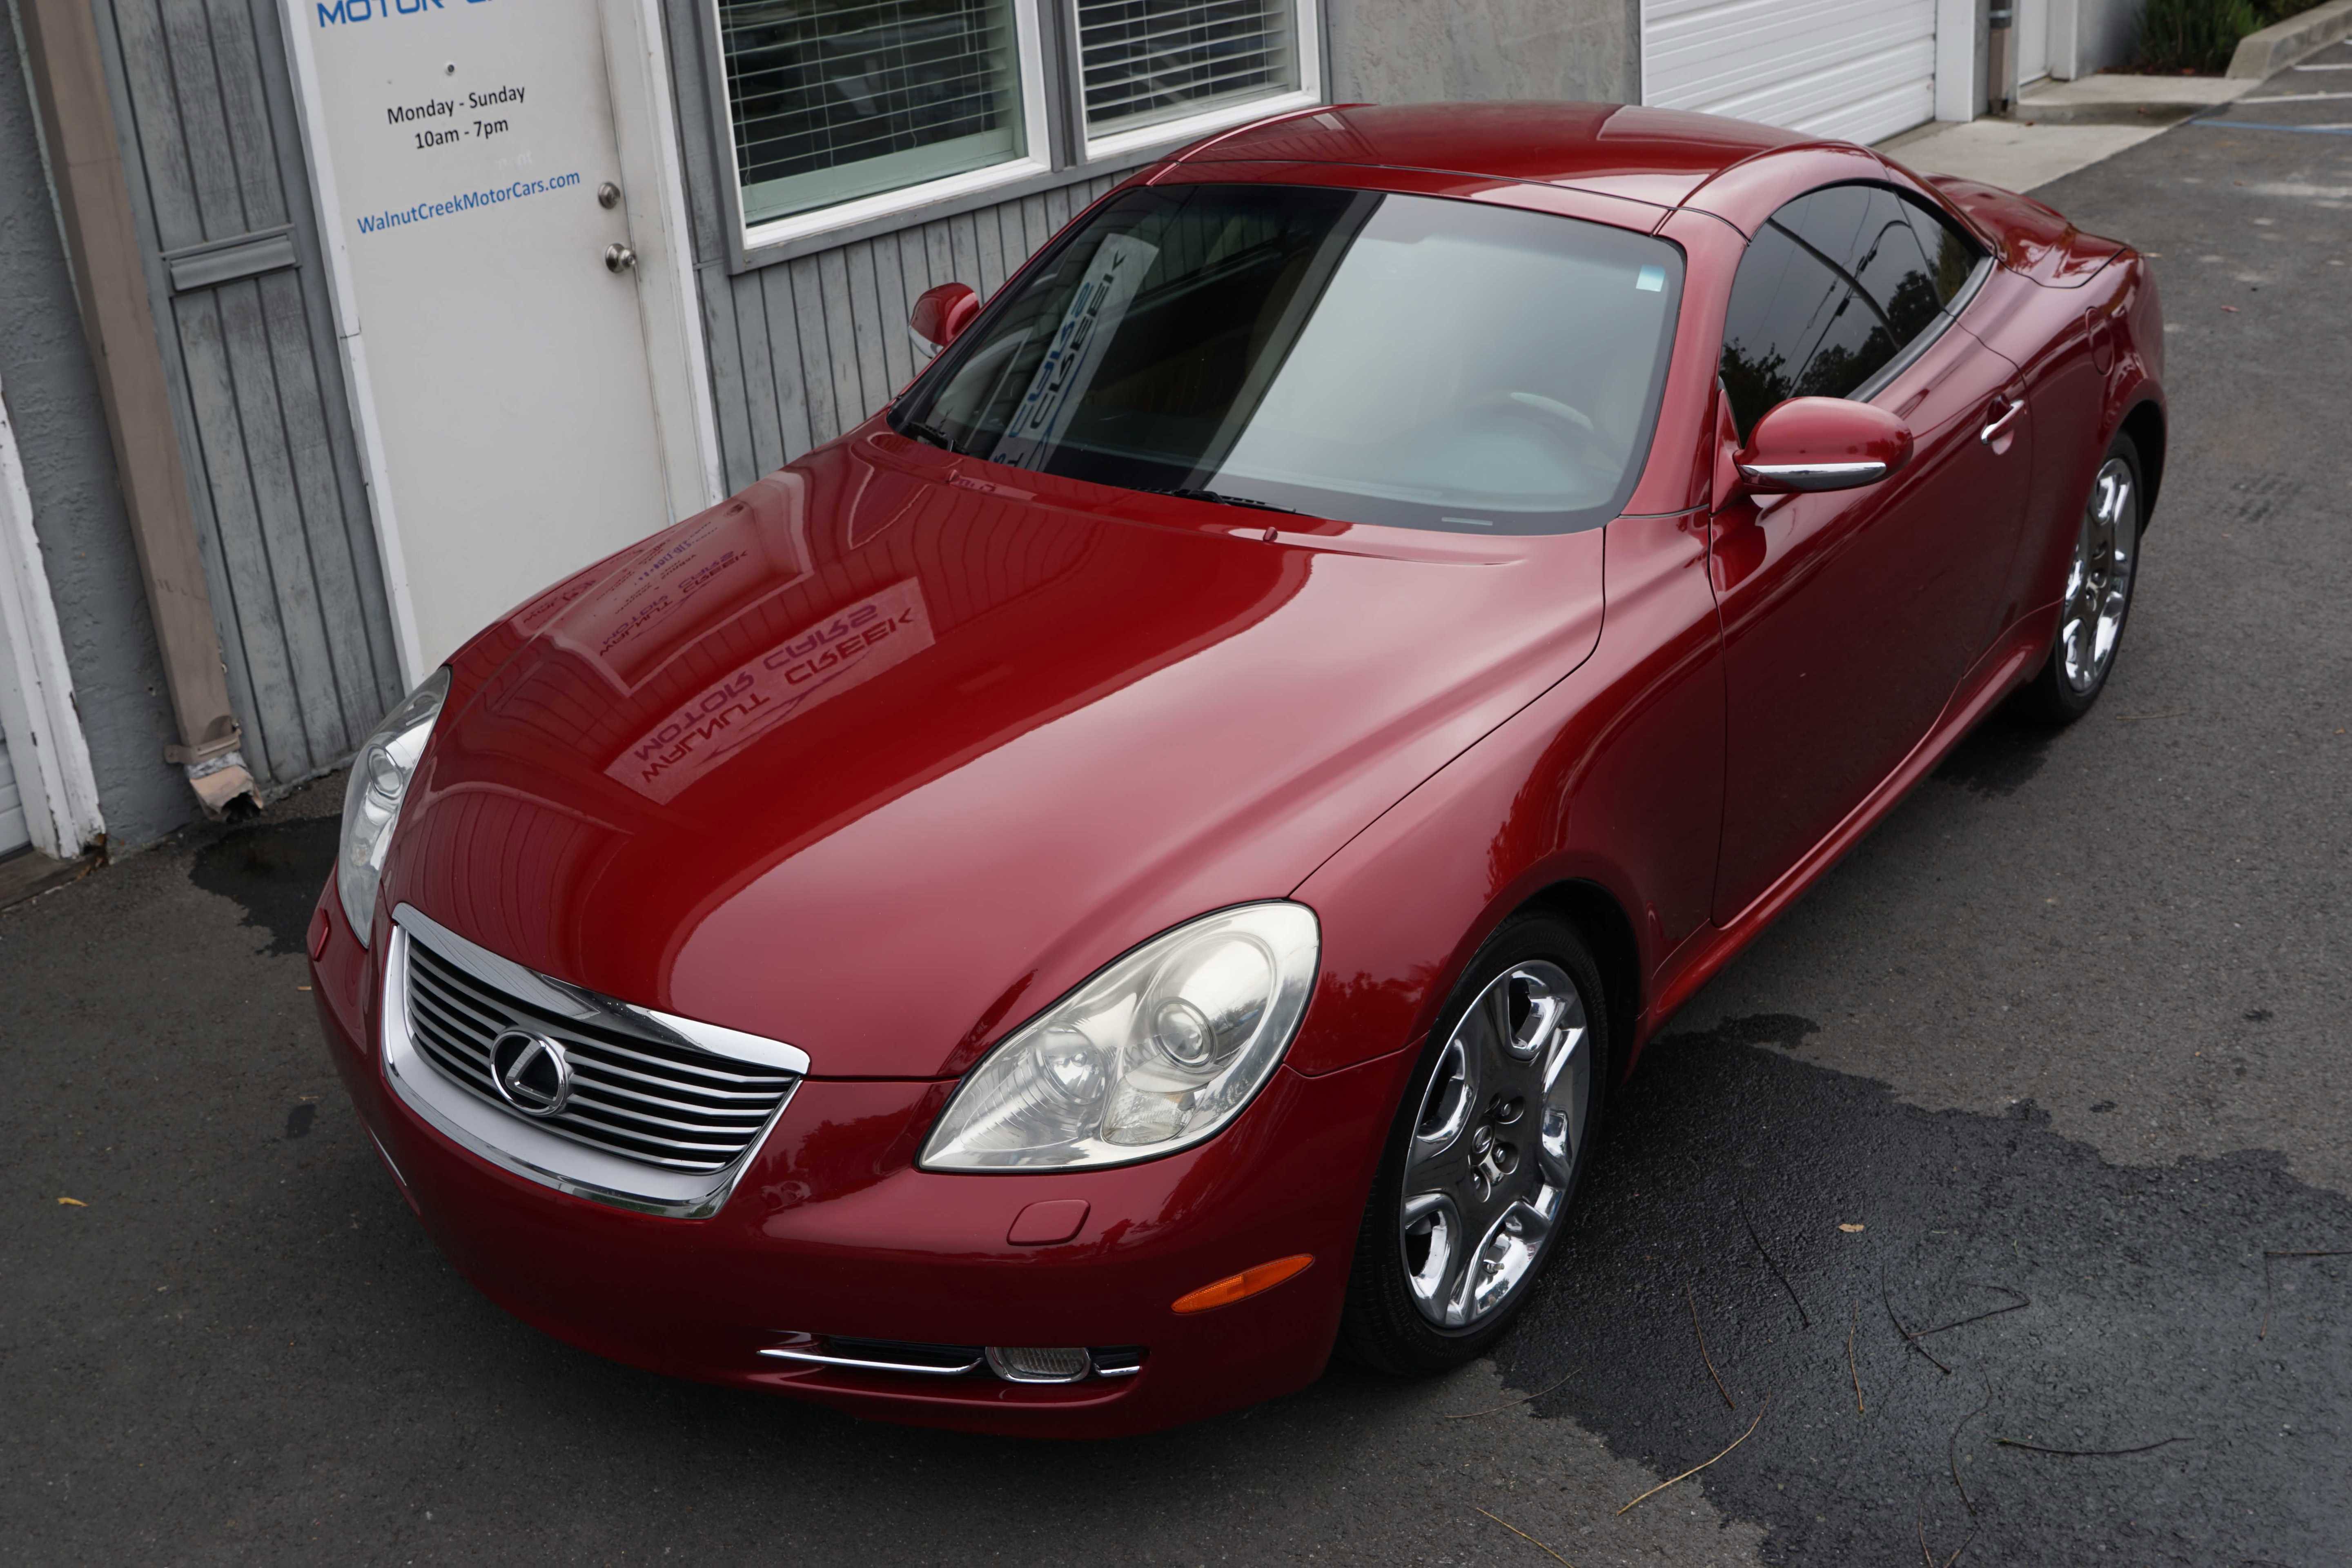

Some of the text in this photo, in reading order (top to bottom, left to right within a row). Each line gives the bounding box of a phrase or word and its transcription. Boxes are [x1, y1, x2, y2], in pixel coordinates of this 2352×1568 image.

[387, 99, 454, 125] Monday
[468, 85, 525, 109] Sunday
[415, 129, 459, 149] 10am
[473, 119, 508, 139] 7pm
[357, 172, 580, 234] WalnutCreekMotorCars.com
